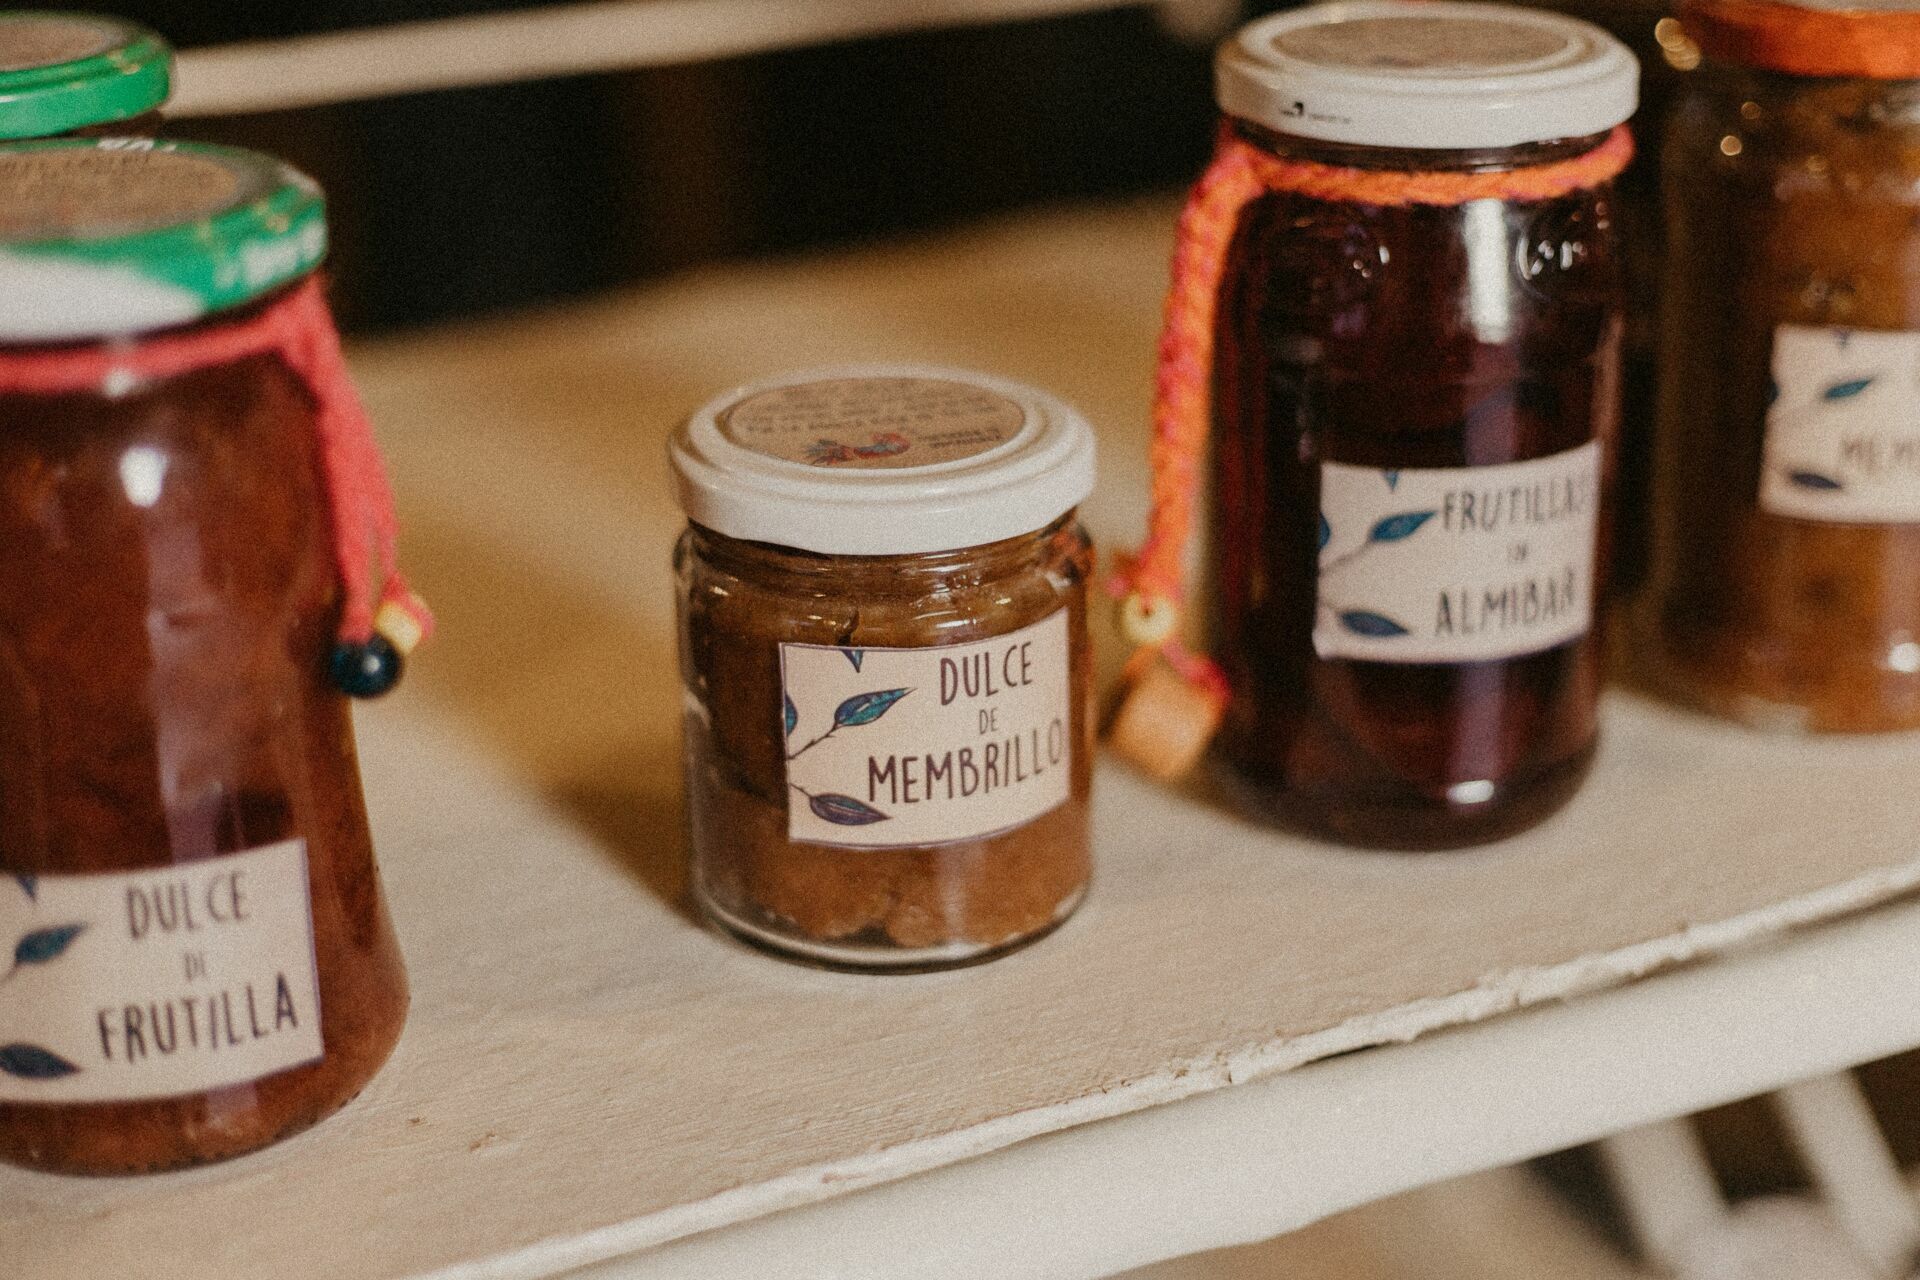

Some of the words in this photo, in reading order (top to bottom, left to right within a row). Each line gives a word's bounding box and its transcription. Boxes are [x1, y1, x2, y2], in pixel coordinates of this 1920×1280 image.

[1435, 566, 1576, 637] ALMIBAR
[940, 641, 1033, 706] DULCE
[978, 707, 999, 735] DE
[868, 718, 1064, 804] MEMBRILLO
[126, 870, 250, 941] DULCE
[97, 970, 298, 1064] FRUTILLA
